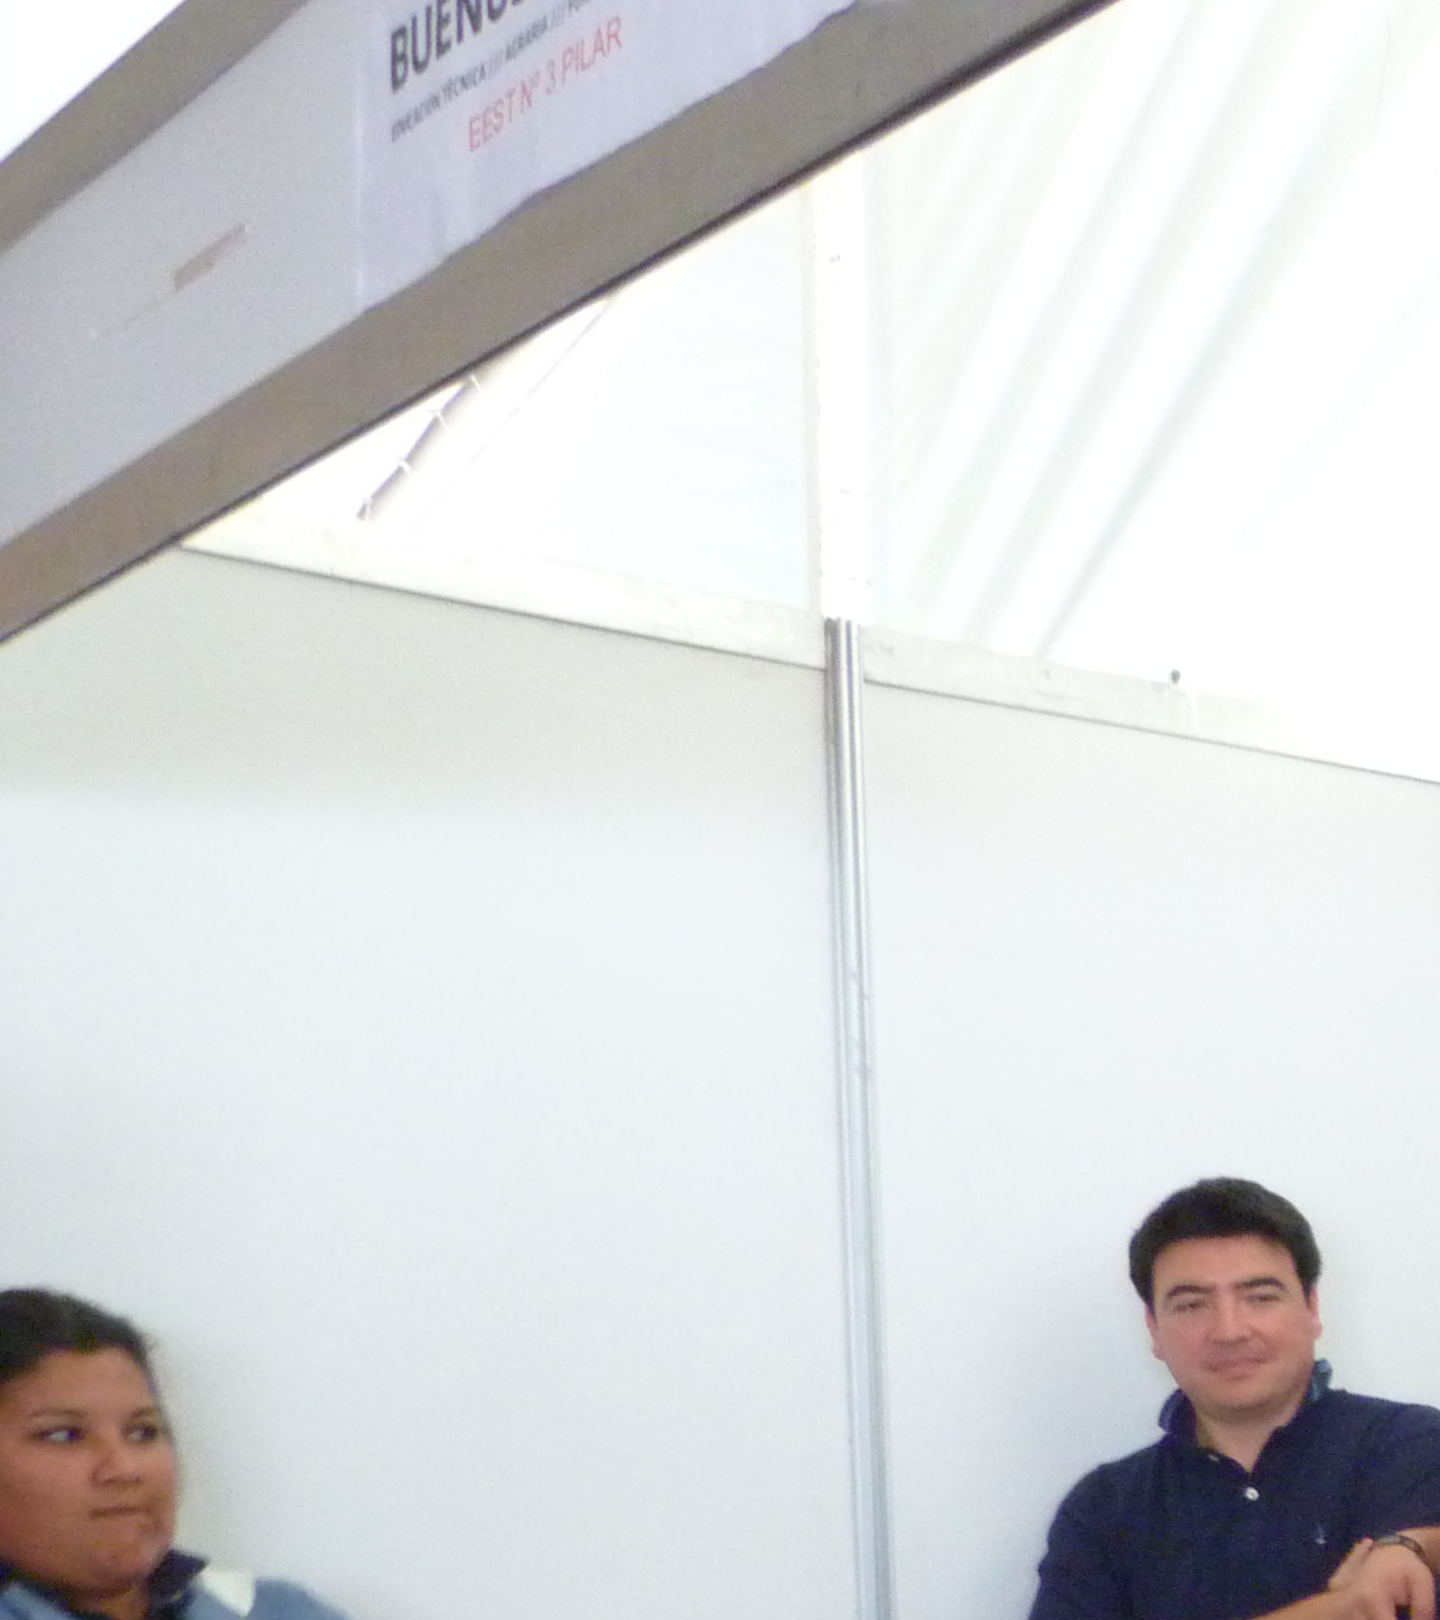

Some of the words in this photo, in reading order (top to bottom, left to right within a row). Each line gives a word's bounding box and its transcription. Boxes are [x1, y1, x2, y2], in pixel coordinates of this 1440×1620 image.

[391, 0, 524, 94] BUEN
[545, 58, 556, 96] 3
[561, 15, 622, 86] PILAR
